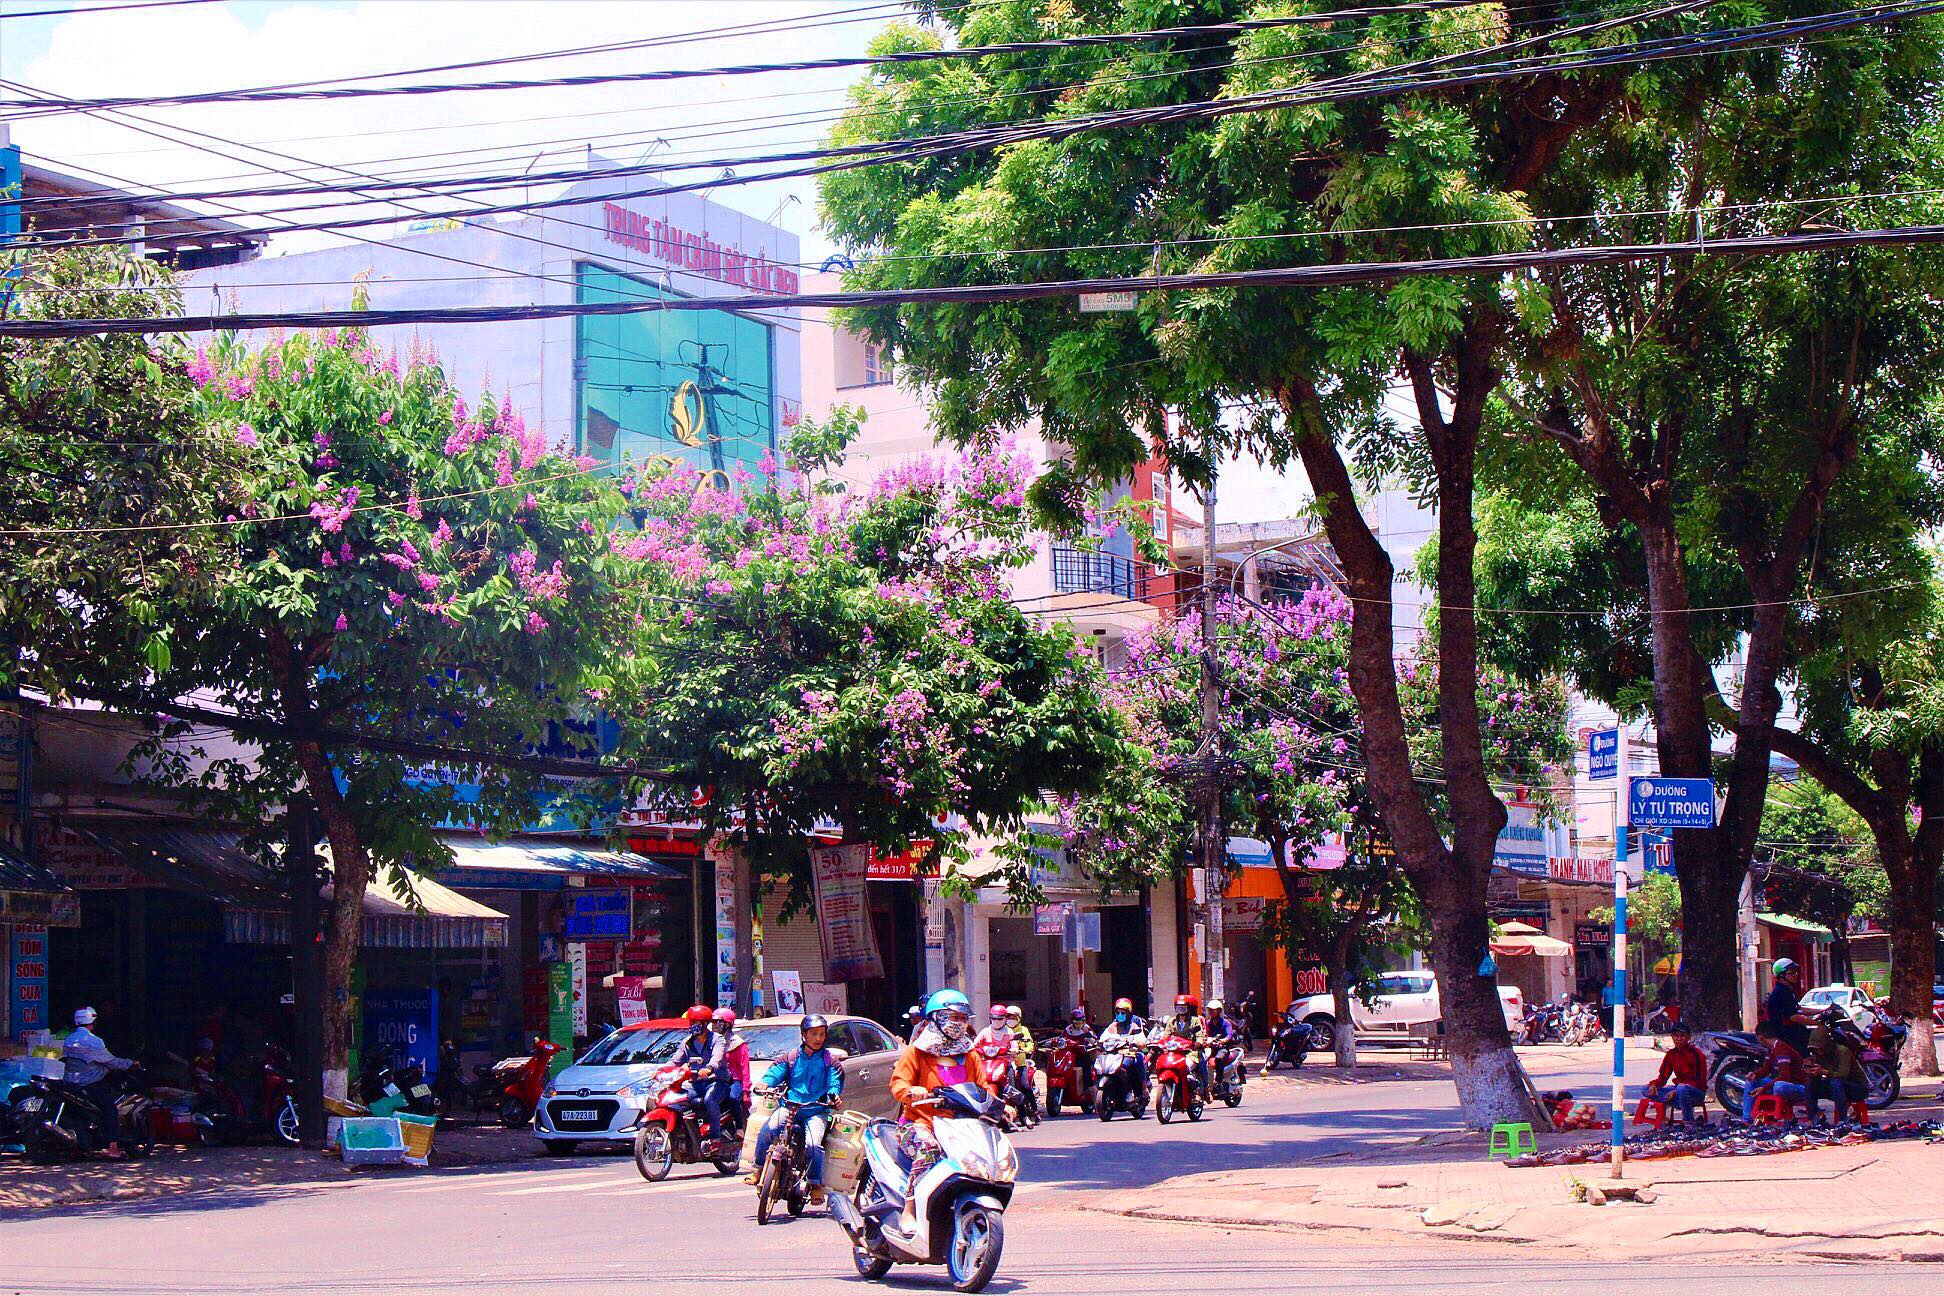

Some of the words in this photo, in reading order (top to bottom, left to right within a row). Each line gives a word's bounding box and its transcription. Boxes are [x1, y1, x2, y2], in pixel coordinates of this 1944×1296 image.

[603, 201, 650, 254] TRUNG
[653, 216, 683, 265] TÂM
[685, 231, 721, 280] CHĂM
[1591, 752, 1604, 768] NGÔ
[1655, 784, 1687, 797] ĐƯỜNG
[1632, 799, 1646, 815] LÝ
[1650, 800, 1666, 818] TỰ
[1669, 801, 1709, 818] TRỌNG
[821, 853, 842, 869] 50
[867, 863, 879, 874] đến
[879, 863, 891, 875] hết
[891, 865, 906, 876] 31/3
[1550, 857, 1574, 880] THANH
[1594, 860, 1613, 881] HOTEL
[16, 960, 45, 978] SỐNG
[1296, 966, 1327, 995] SƠN
[19, 985, 41, 1001] CUA
[23, 1004, 38, 1023] CÁ
